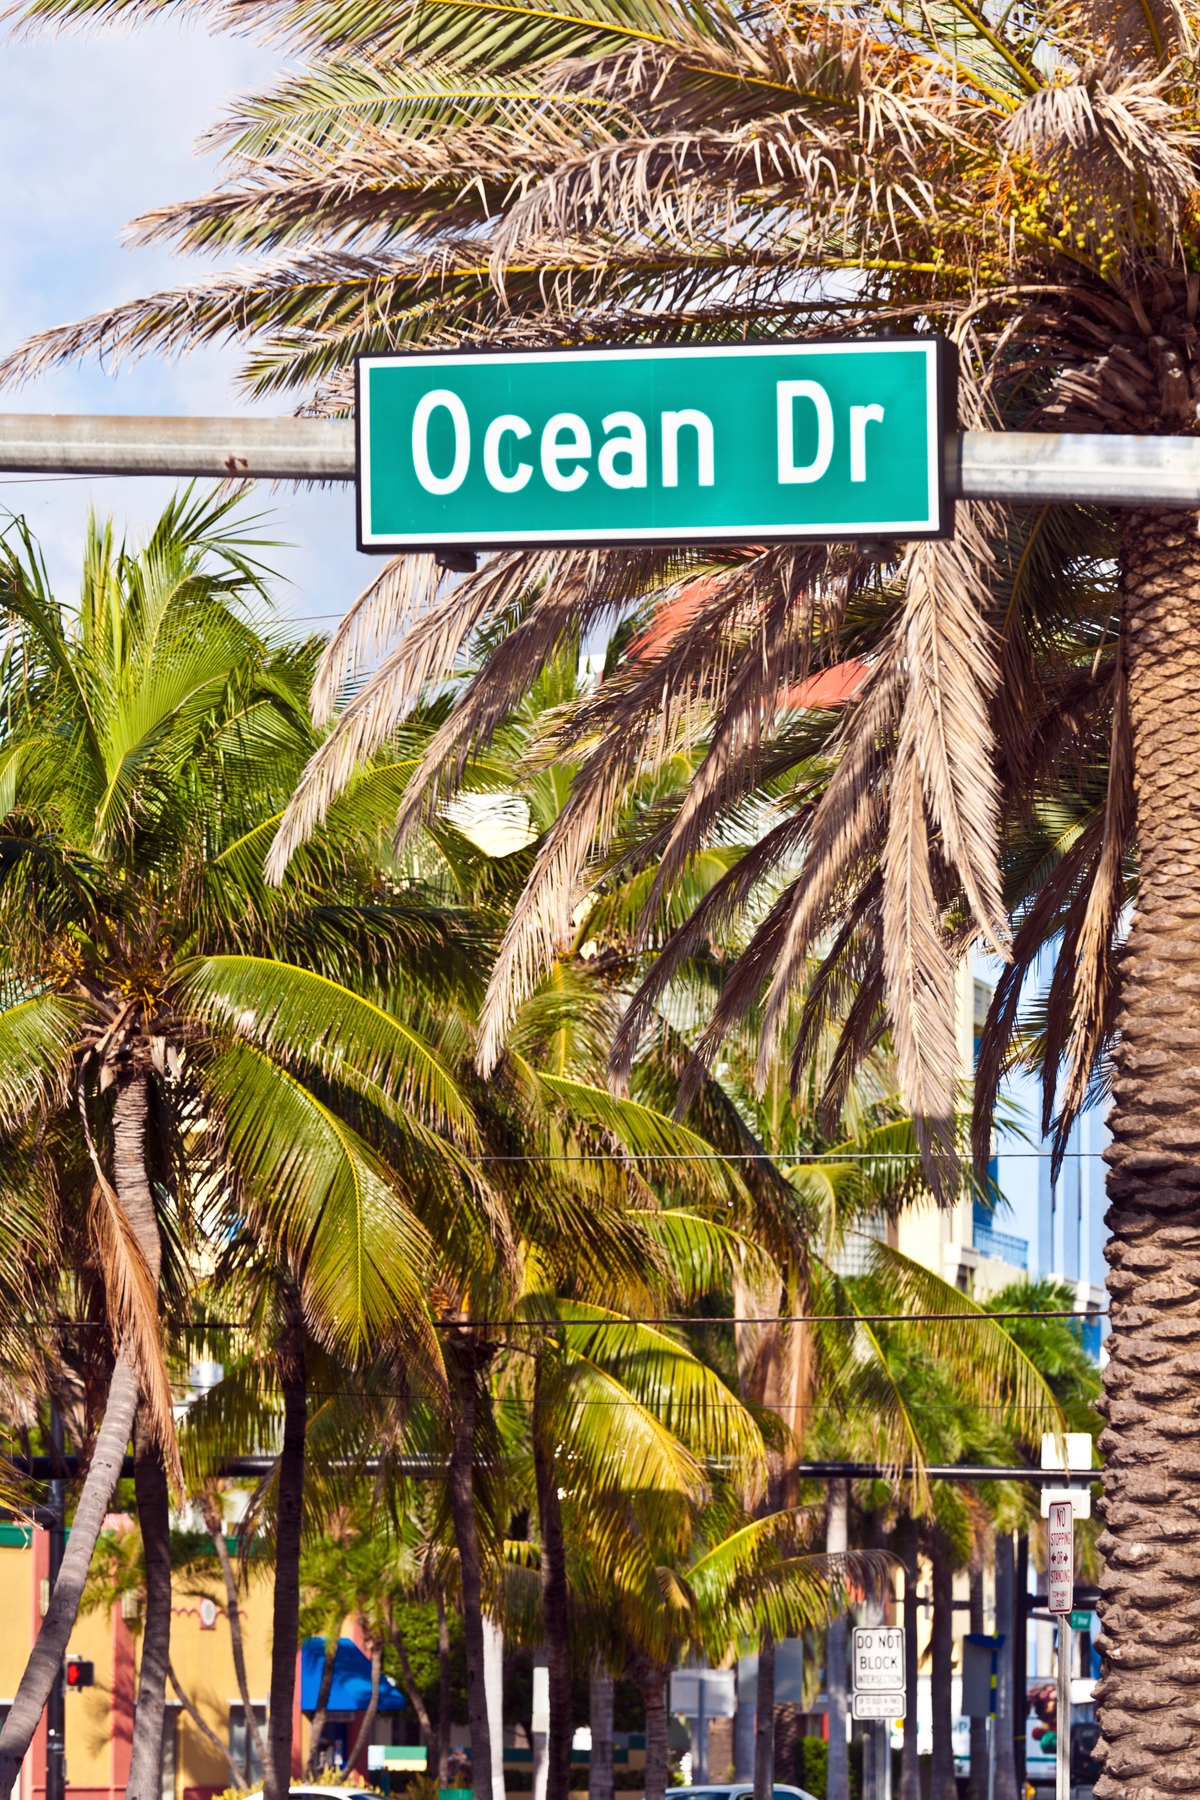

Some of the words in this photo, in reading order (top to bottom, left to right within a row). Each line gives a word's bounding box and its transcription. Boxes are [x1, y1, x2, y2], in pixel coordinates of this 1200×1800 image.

[411, 389, 715, 495] Ocean
[776, 379, 885, 485] Dr
[1056, 1507, 1066, 1527] NO
[1050, 1531, 1071, 1546] STOPPING
[1056, 1550, 1063, 1564] OR
[1050, 1569, 1070, 1584] STANDING
[857, 1635, 873, 1649] DO
[878, 1635, 902, 1649] NOT
[860, 1656, 898, 1670] BLOCK
[857, 1674, 902, 1685] INTERSECTION
